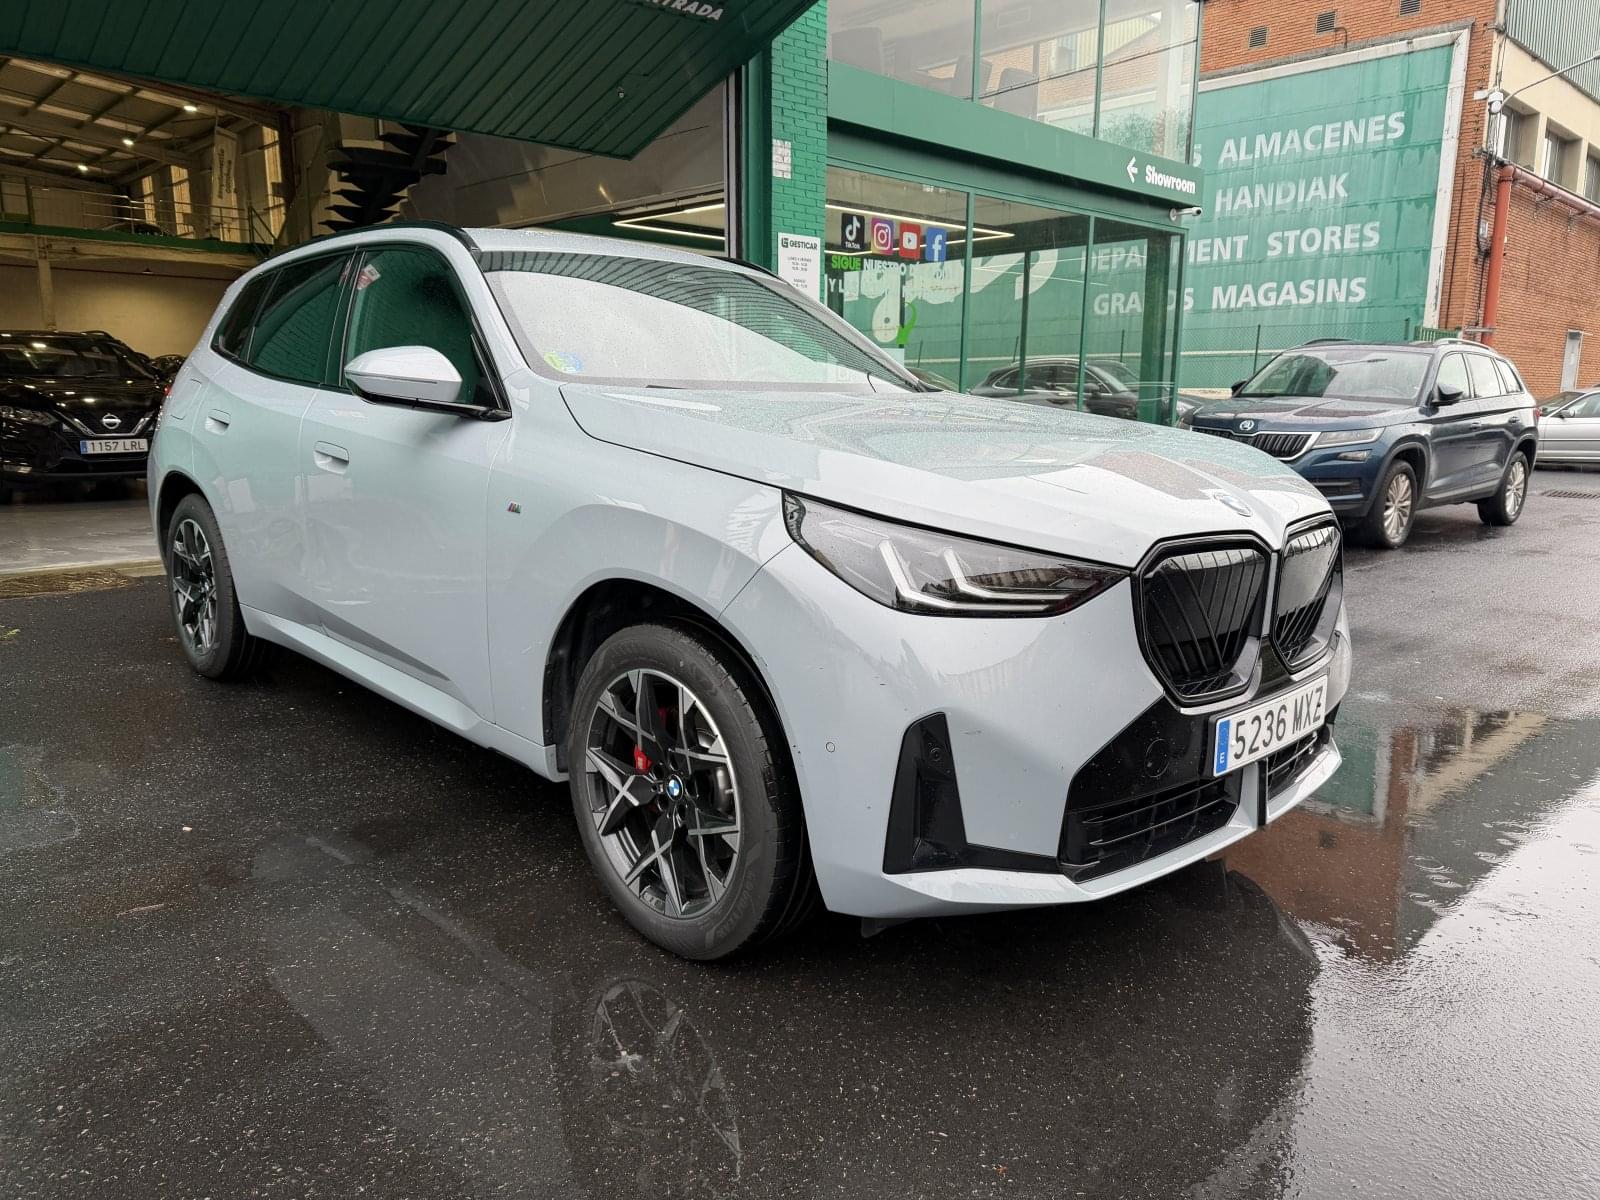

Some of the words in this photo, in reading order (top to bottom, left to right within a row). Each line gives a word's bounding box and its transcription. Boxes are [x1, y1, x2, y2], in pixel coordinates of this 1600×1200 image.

[645, 0, 723, 20] RADA
[1218, 111, 1405, 163] ALMACENES
[1145, 164, 1196, 194] Showroom
[1215, 172, 1350, 213] HANDIAK
[789, 239, 818, 250] GESTICAR
[1080, 231, 1248, 275] DEPAMENT
[1267, 221, 1380, 257] STORES
[831, 254, 861, 271] SIGUE
[1093, 287, 1194, 316] GRADS
[1212, 277, 1367, 310] MAGASINS
[91, 441, 119, 452] 1157
[123, 440, 145, 451] LRL
[1233, 704, 1288, 760] 5236
[1292, 685, 1323, 735] MXZ
